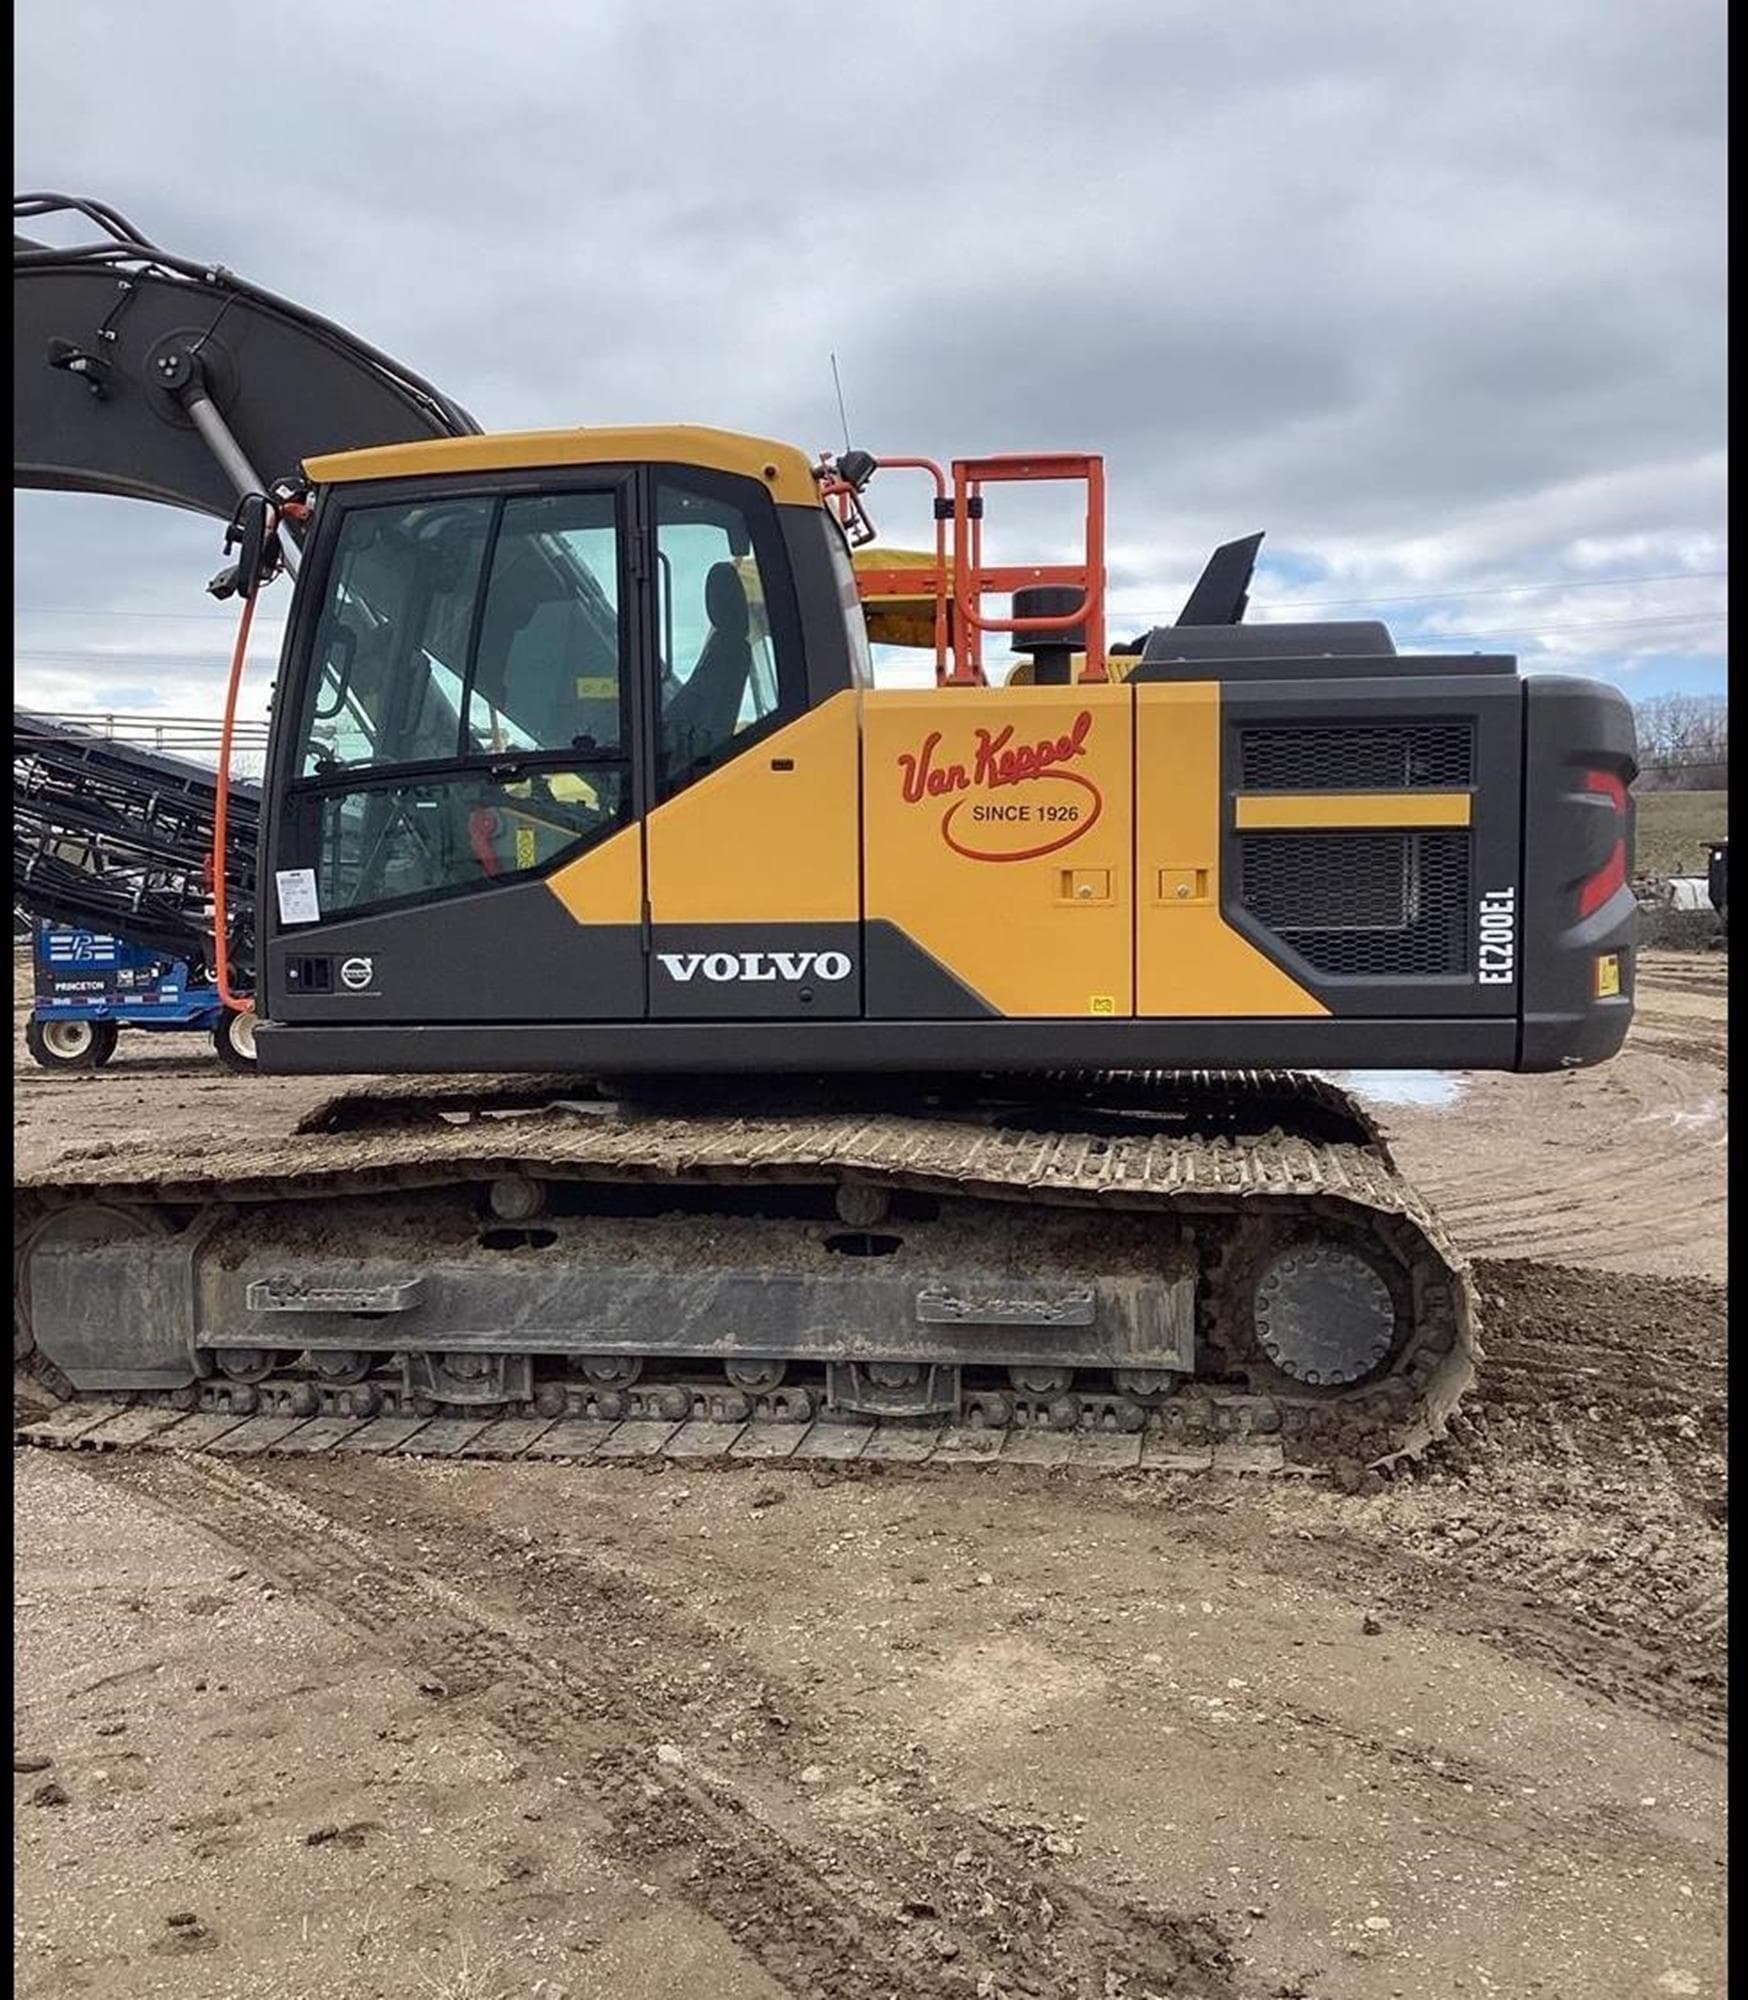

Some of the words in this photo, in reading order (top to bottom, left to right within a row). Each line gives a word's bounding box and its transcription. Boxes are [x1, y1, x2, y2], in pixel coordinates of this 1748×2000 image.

[898, 731, 970, 804] Van
[974, 710, 1093, 789] Keppel
[972, 806, 1030, 822] SINCE
[1037, 806, 1079, 822] 1926
[1478, 886, 1515, 984] EC200EL
[656, 951, 851, 981] VOLVO
[55, 981, 105, 991] PRINCETON
